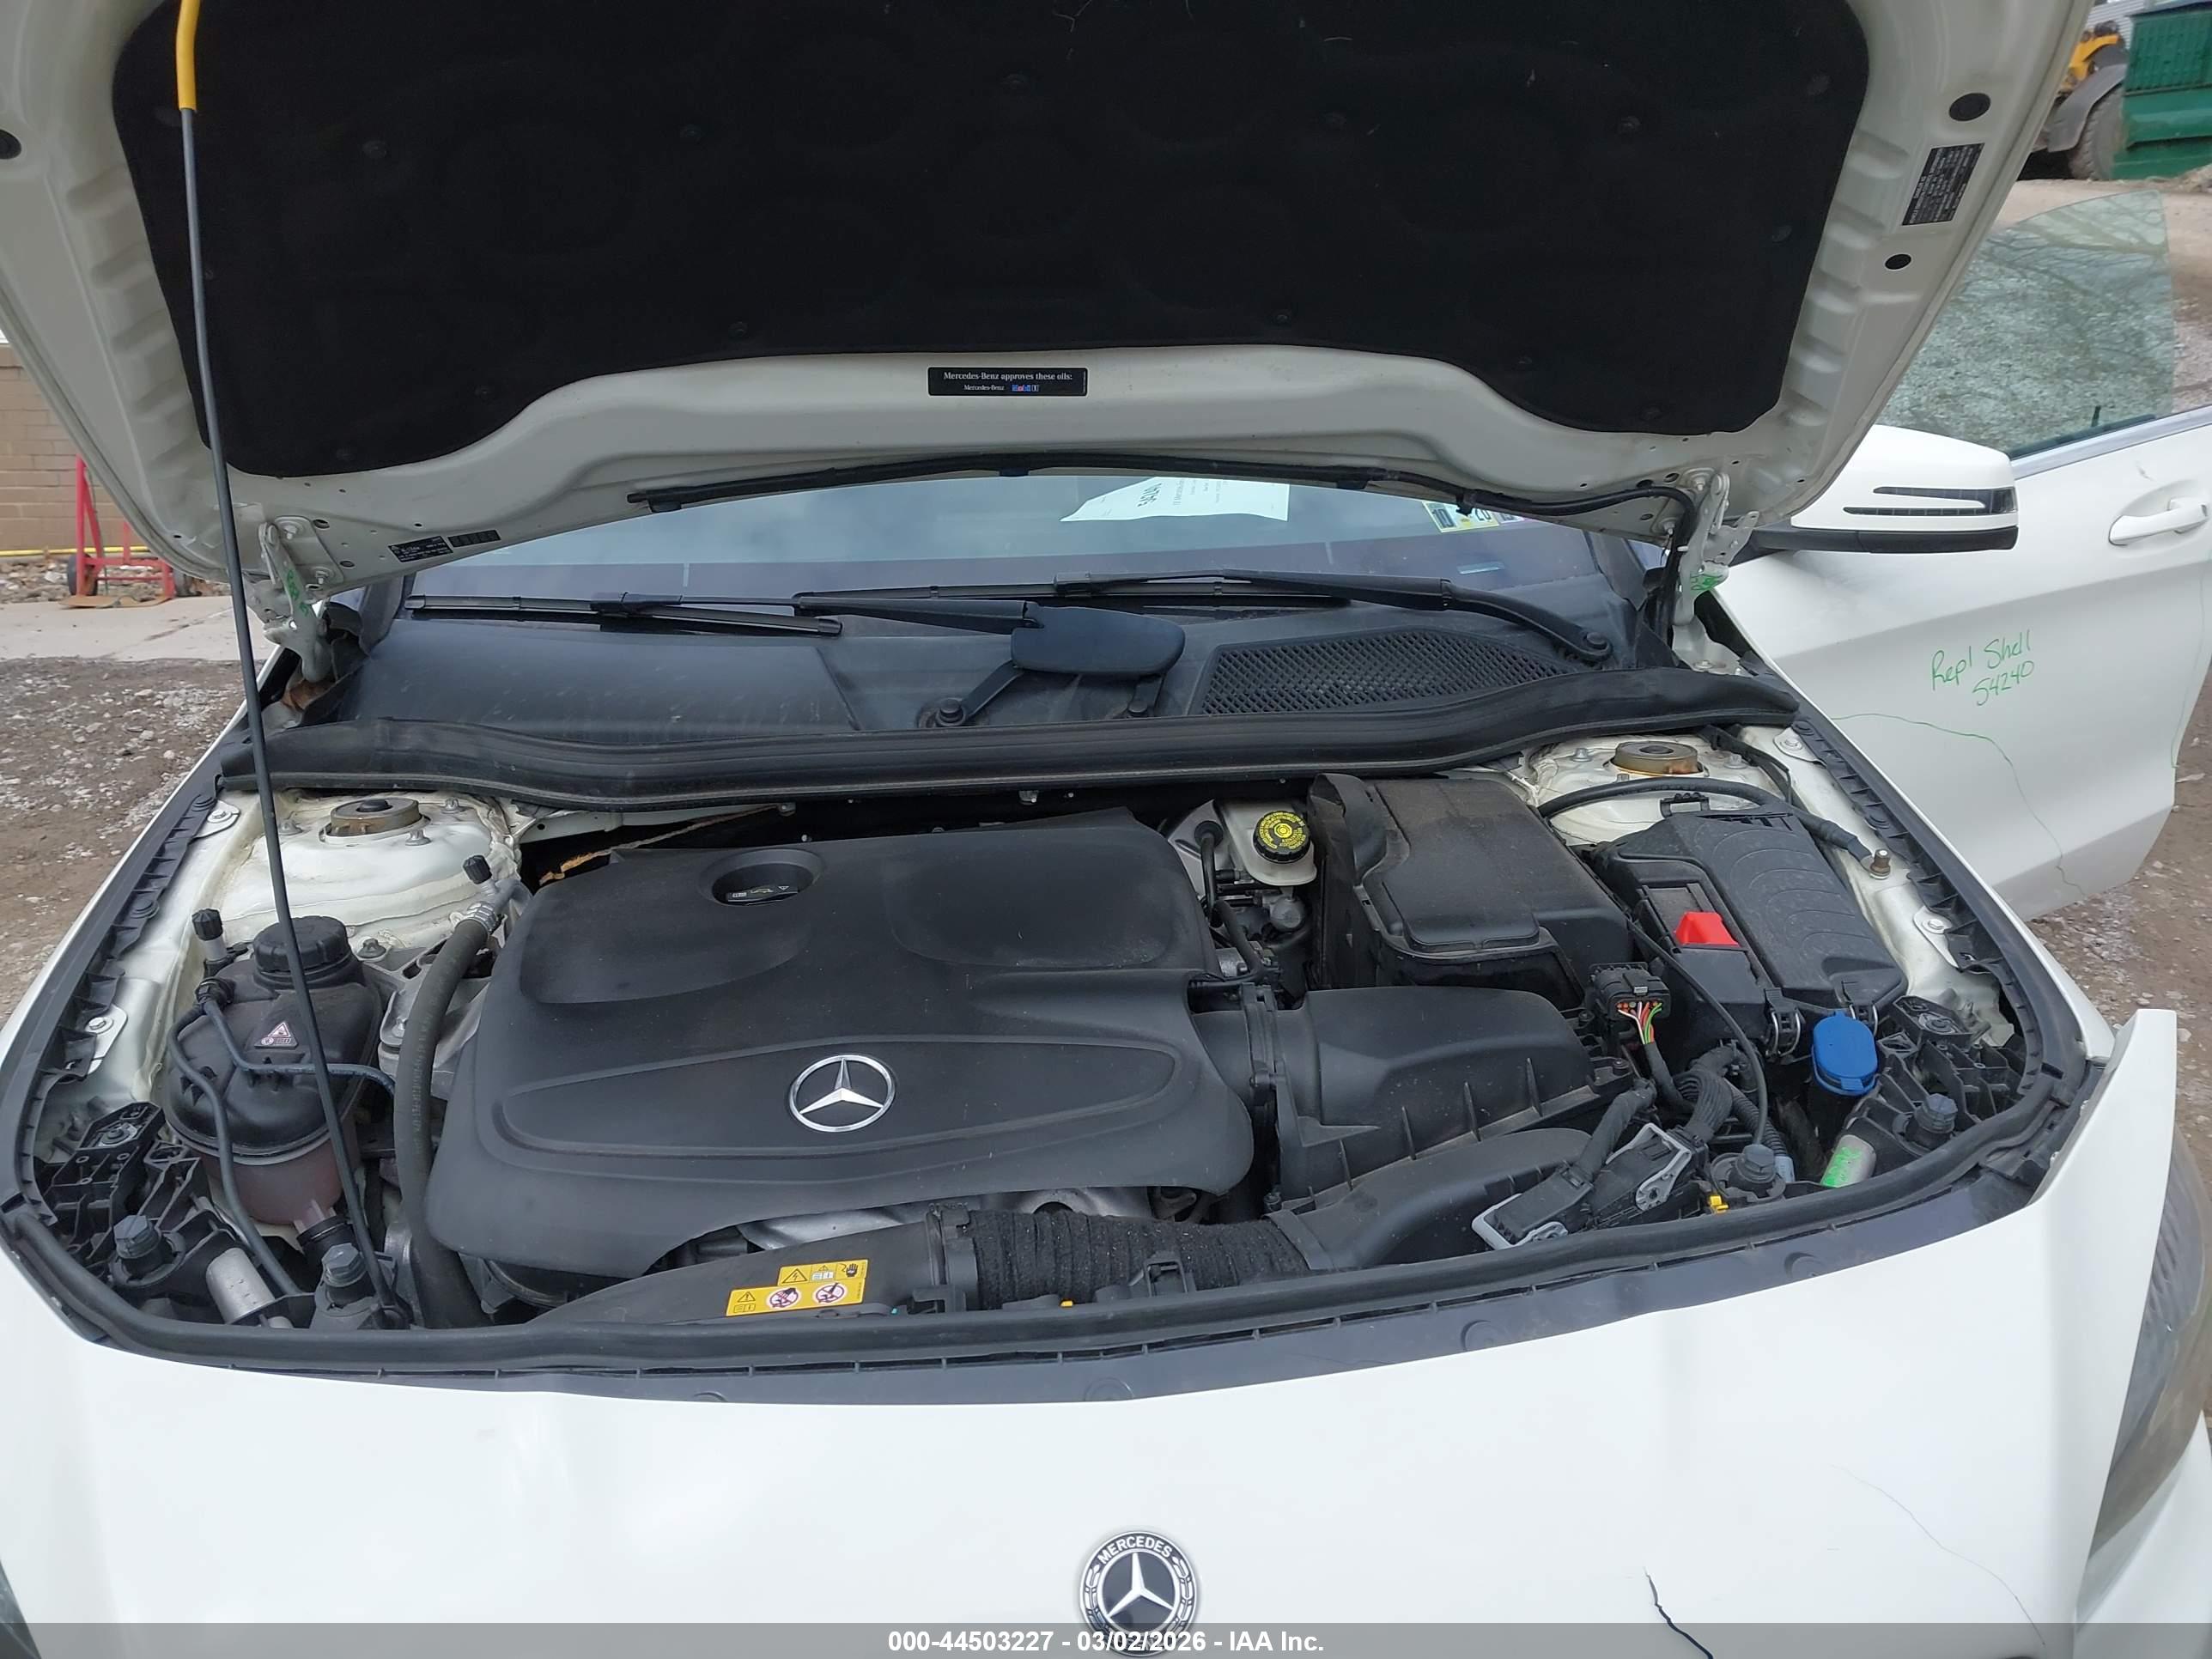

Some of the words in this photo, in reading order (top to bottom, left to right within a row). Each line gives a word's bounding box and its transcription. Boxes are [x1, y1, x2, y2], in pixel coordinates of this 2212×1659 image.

[944, 372, 999, 380] Mercedes-Benz
[1000, 372, 1034, 382] approves
[1035, 372, 1055, 380] these
[1056, 372, 1073, 380] oils:
[1972, 660, 2034, 706] 54240
[1097, 1534, 1173, 1565] MERCEDES
